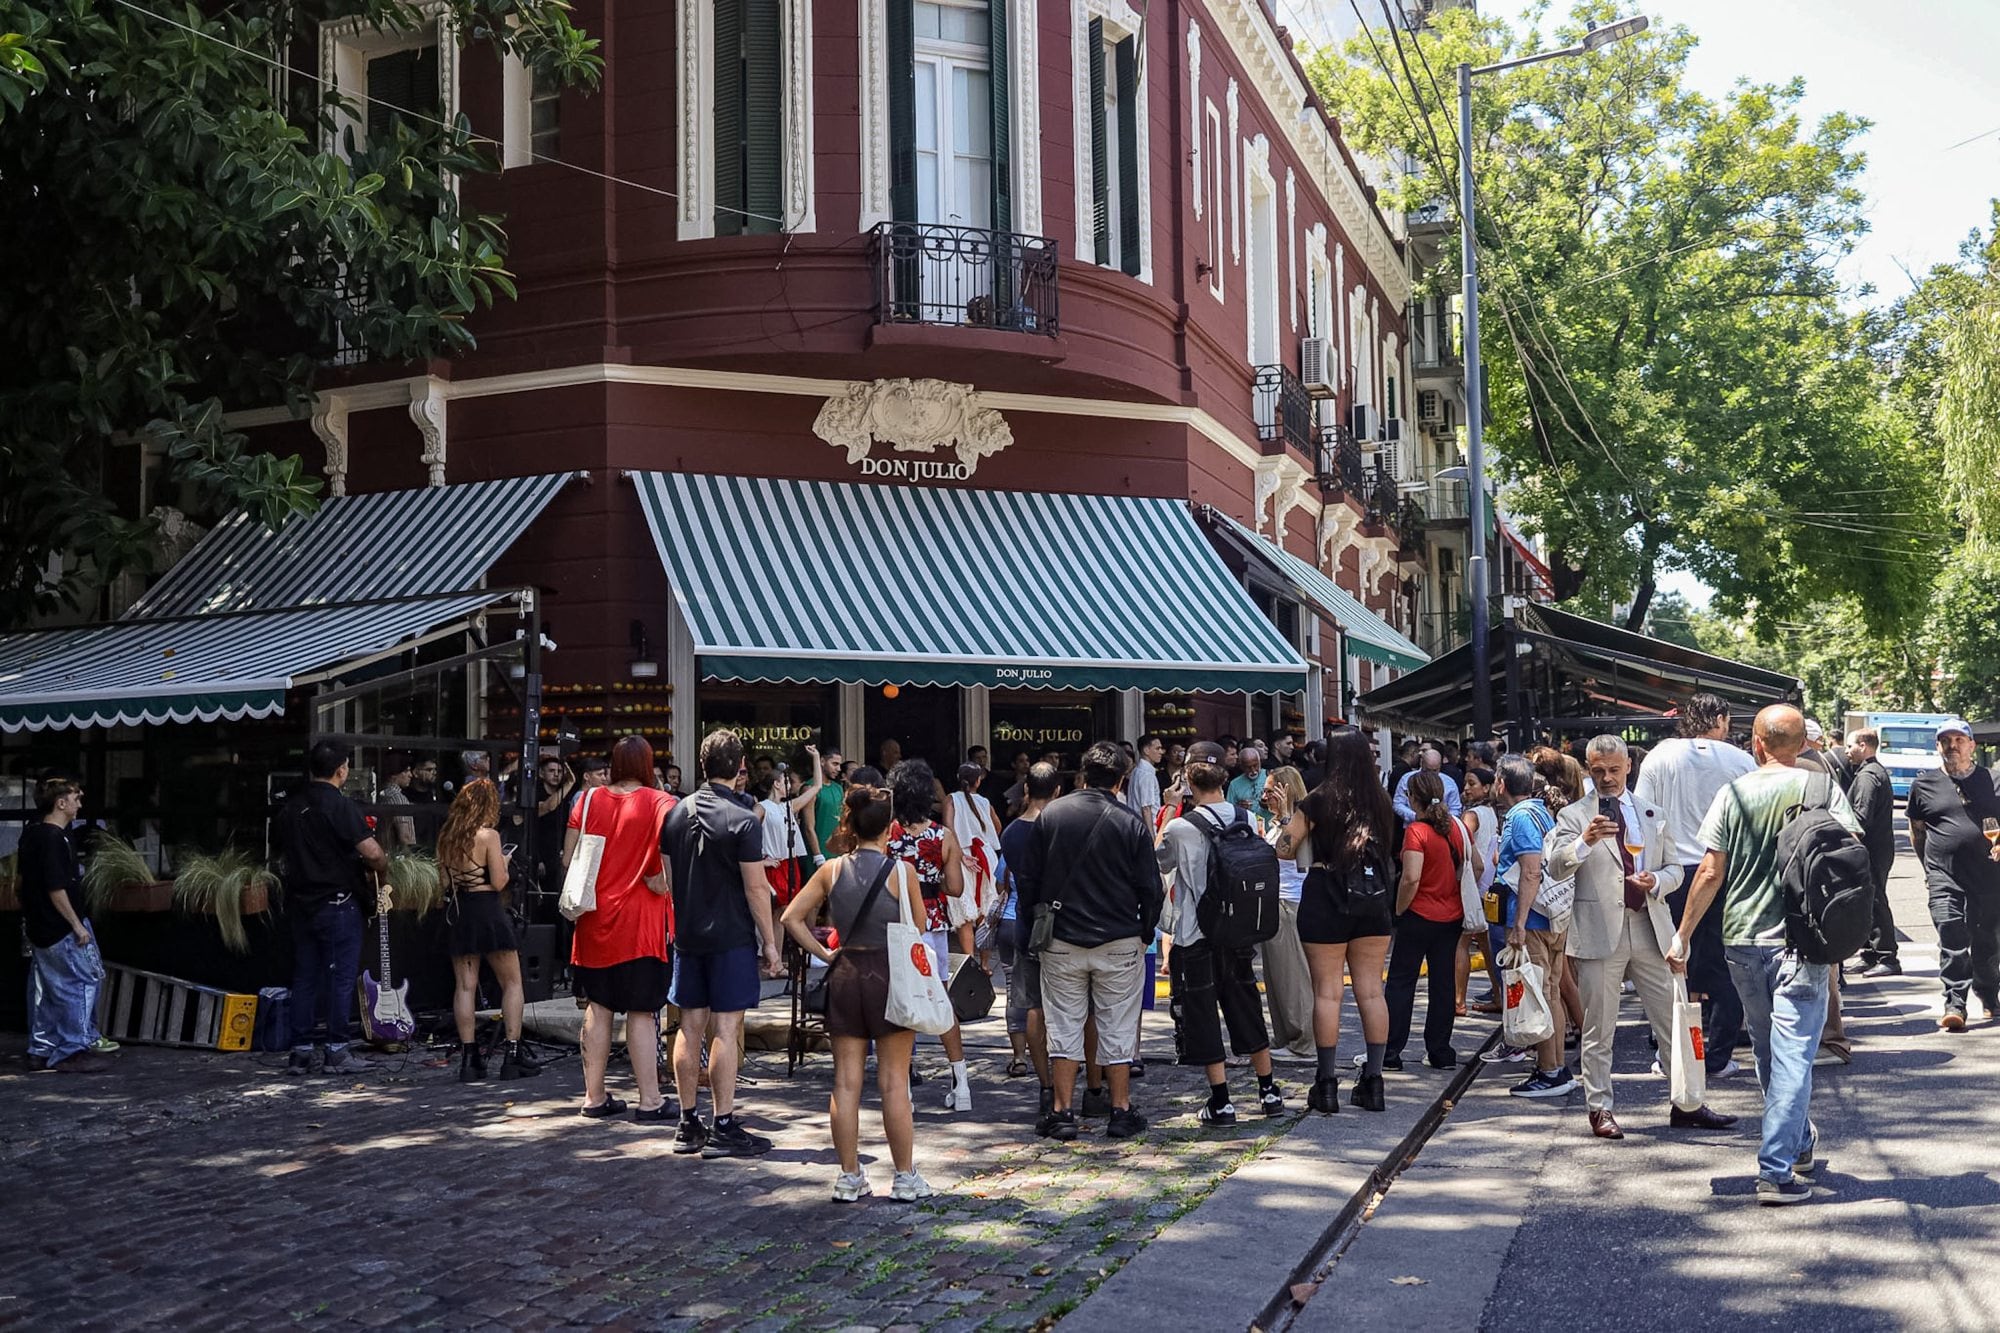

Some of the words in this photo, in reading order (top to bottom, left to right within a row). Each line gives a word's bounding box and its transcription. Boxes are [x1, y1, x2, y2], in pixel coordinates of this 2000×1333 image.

[860, 458, 909, 477] DON
[909, 461, 970, 483] JULIO
[996, 669, 1019, 678] DON
[1019, 669, 1052, 680] JULIO
[732, 727, 755, 740] ON
[759, 727, 811, 743] JULIO
[1000, 728, 1034, 741] DON
[1036, 729, 1083, 744] JULIO
